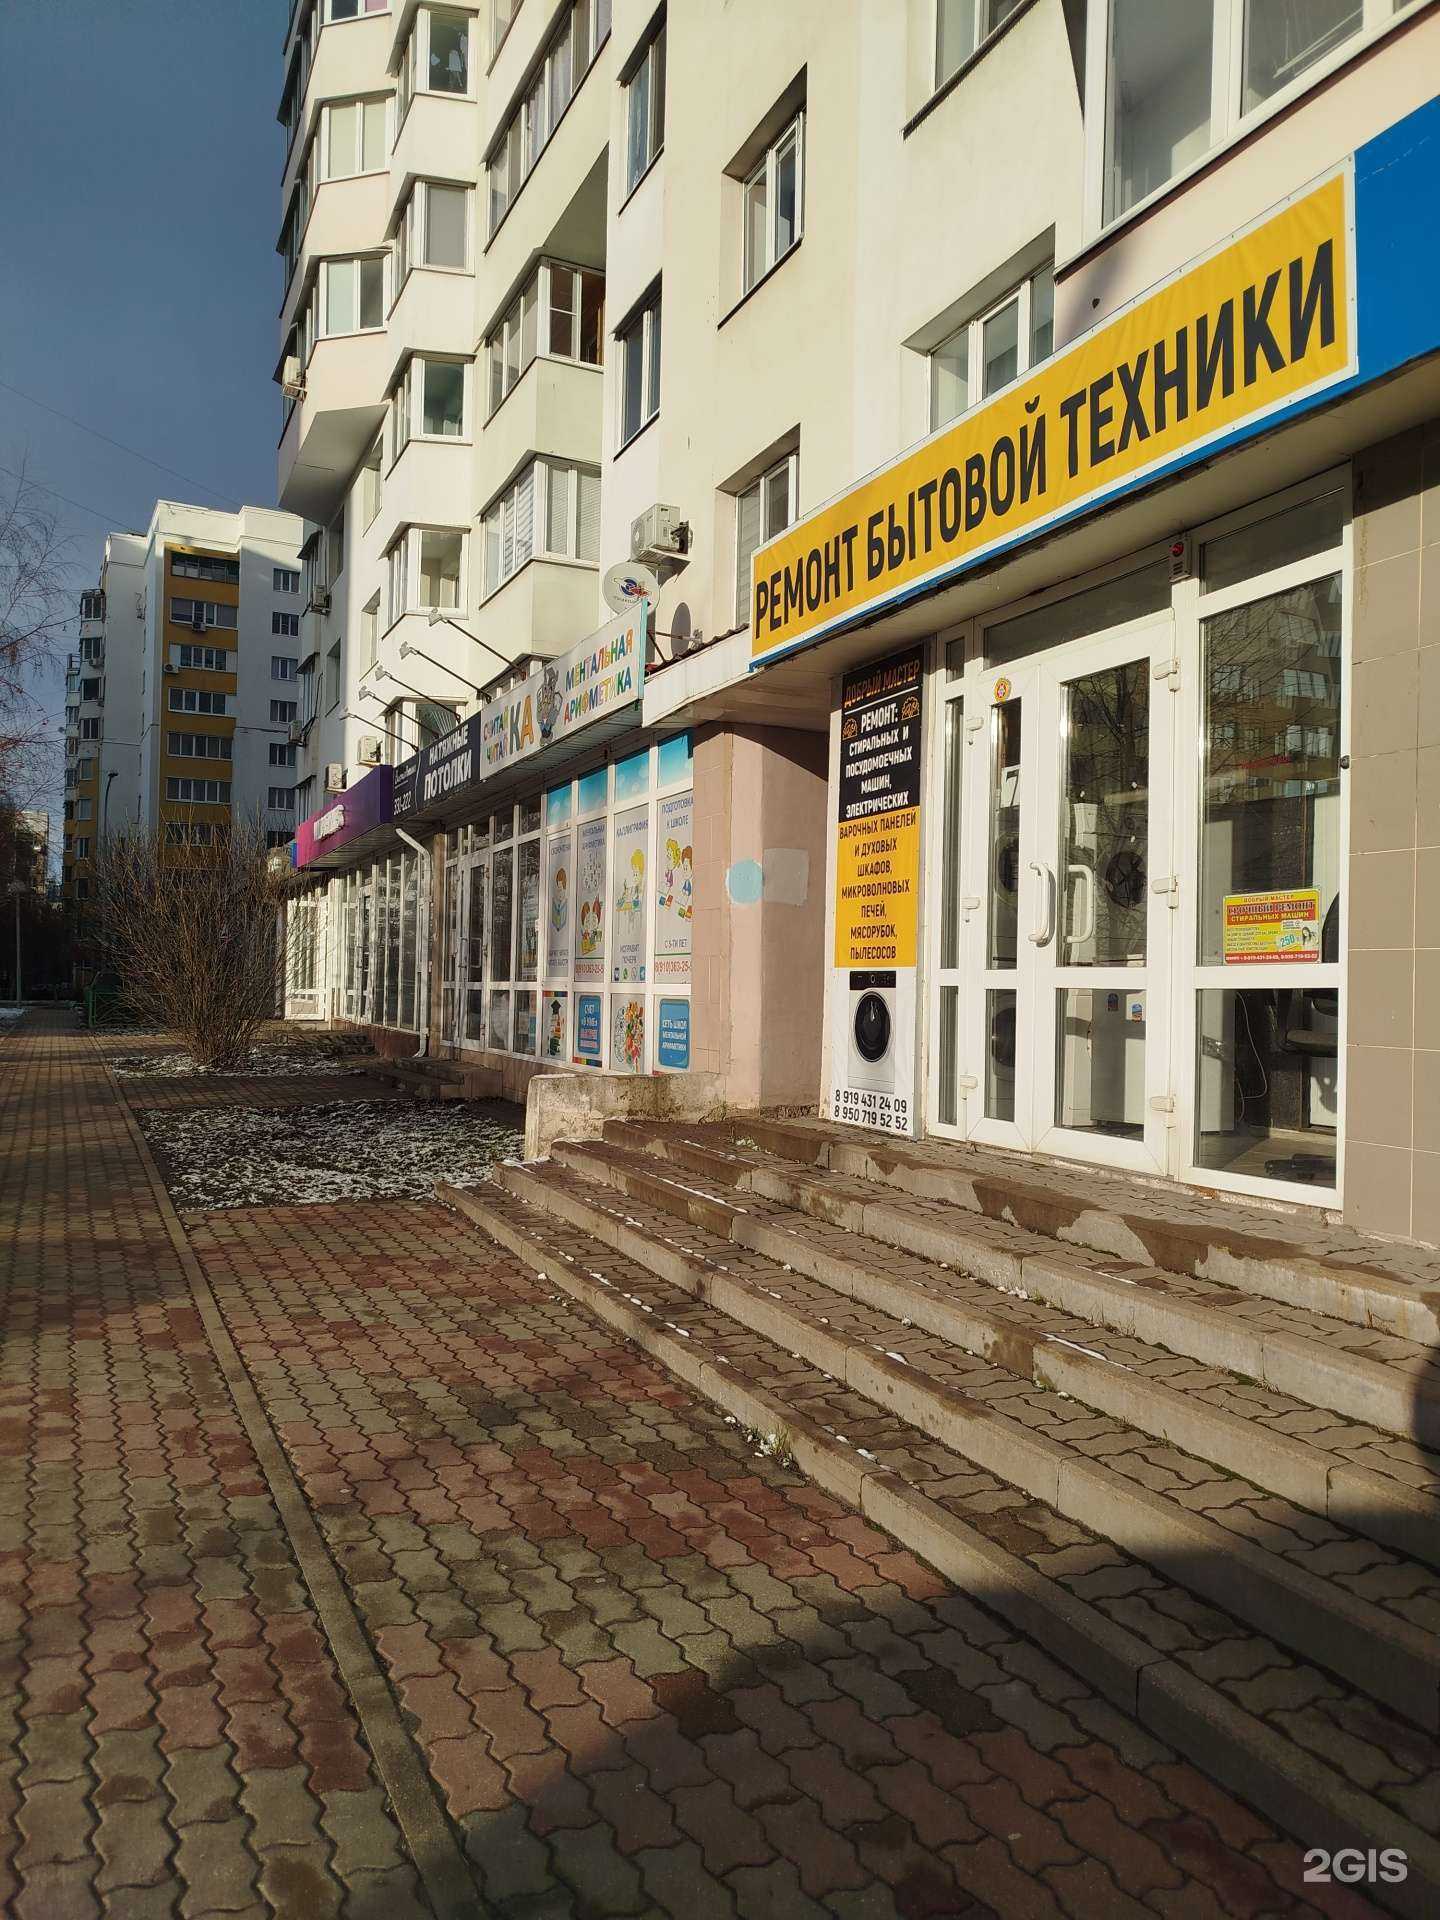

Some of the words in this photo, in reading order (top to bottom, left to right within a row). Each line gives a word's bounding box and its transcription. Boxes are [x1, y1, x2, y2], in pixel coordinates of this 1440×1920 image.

[756, 525, 858, 639] РЕМОНТ
[866, 396, 1047, 581] БЫТОВОЙ
[1059, 239, 1336, 478] ТЕХНИКИ
[565, 627, 634, 693] МЕНТАЛЬНАЯ
[563, 666, 632, 726] АРИФМЕТИКА
[844, 670, 882, 708] ДОБРЫЙ
[883, 659, 920, 691] МАСТЕР
[483, 705, 509, 742] СЧИТАЙ
[860, 702, 899, 734] РЕМОНТ:
[429, 723, 469, 766] НАТЯЖНЫЕ
[849, 728, 899, 757] СТИРАЛЬНЫХ
[902, 725, 909, 741] И
[424, 749, 472, 801] ПОТОЛКИ
[845, 746, 913, 778] ПОСУДОМОЕЧНЫХ
[861, 774, 892, 794] МАШИН,
[845, 791, 909, 818] ЭЛЕКТРИЧЕСКИХ
[671, 815, 689, 828] ШКОЛЕ
[839, 822, 878, 840] ВАРОЧНЫХ
[880, 808, 917, 832] ПАНЕЛЕЙ
[854, 844, 860, 857] И
[861, 837, 897, 858] ДУХОВЫХ
[857, 860, 893, 877] ШКАФОВ,
[841, 879, 910, 899] МИКРОВОЛНОВЫХ
[861, 900, 887, 918] ПЕЧЕЙ,
[1231, 913, 1279, 922] СТИРАЛЬНЫХ
[1281, 911, 1309, 920] МАШИН
[850, 923, 898, 940] МЯСОРУБОК,
[1280, 934, 1295, 947] 250
[850, 945, 897, 960] ПЫЛЕСОСОВ
[835, 1089, 841, 1102] 8
[843, 1091, 859, 1105] 919
[861, 1094, 877, 1109] 431
[879, 1096, 891, 1110] 24
[894, 1099, 907, 1114] 09
[834, 1105, 840, 1117] 8
[842, 1106, 858, 1121] 950
[861, 1109, 877, 1125] 719
[880, 1113, 892, 1128] 52
[895, 1116, 908, 1131] 52
